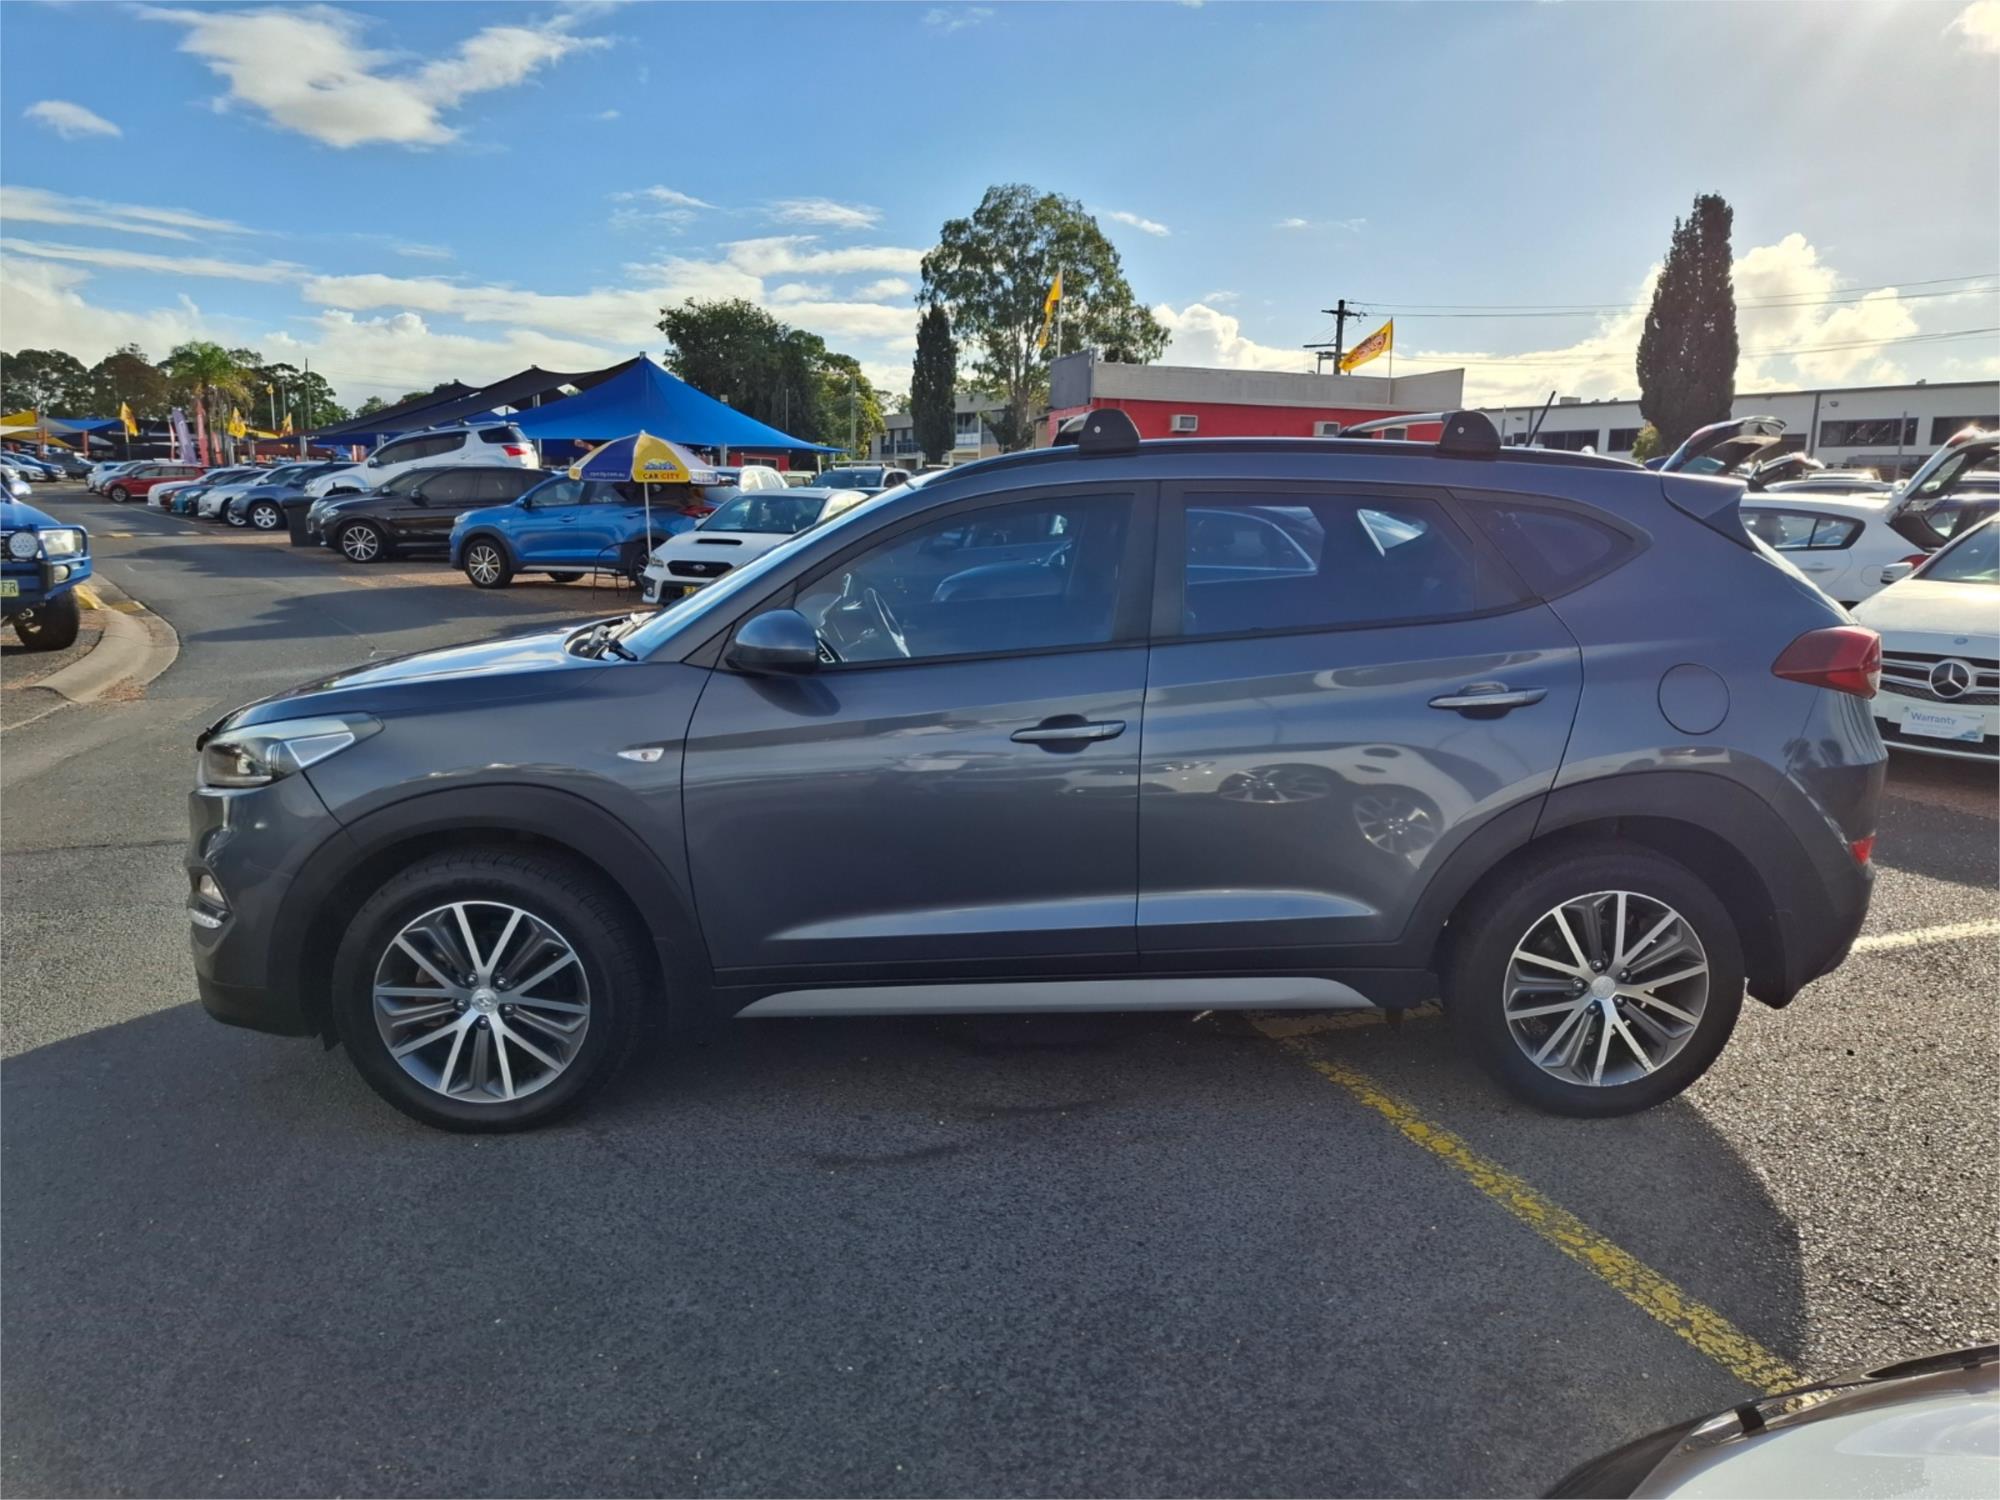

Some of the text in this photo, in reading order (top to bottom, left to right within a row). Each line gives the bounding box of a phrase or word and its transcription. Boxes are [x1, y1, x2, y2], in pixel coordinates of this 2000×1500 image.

[643, 472, 680, 480] CAR CITY
[1911, 712, 1957, 725] Warranty
